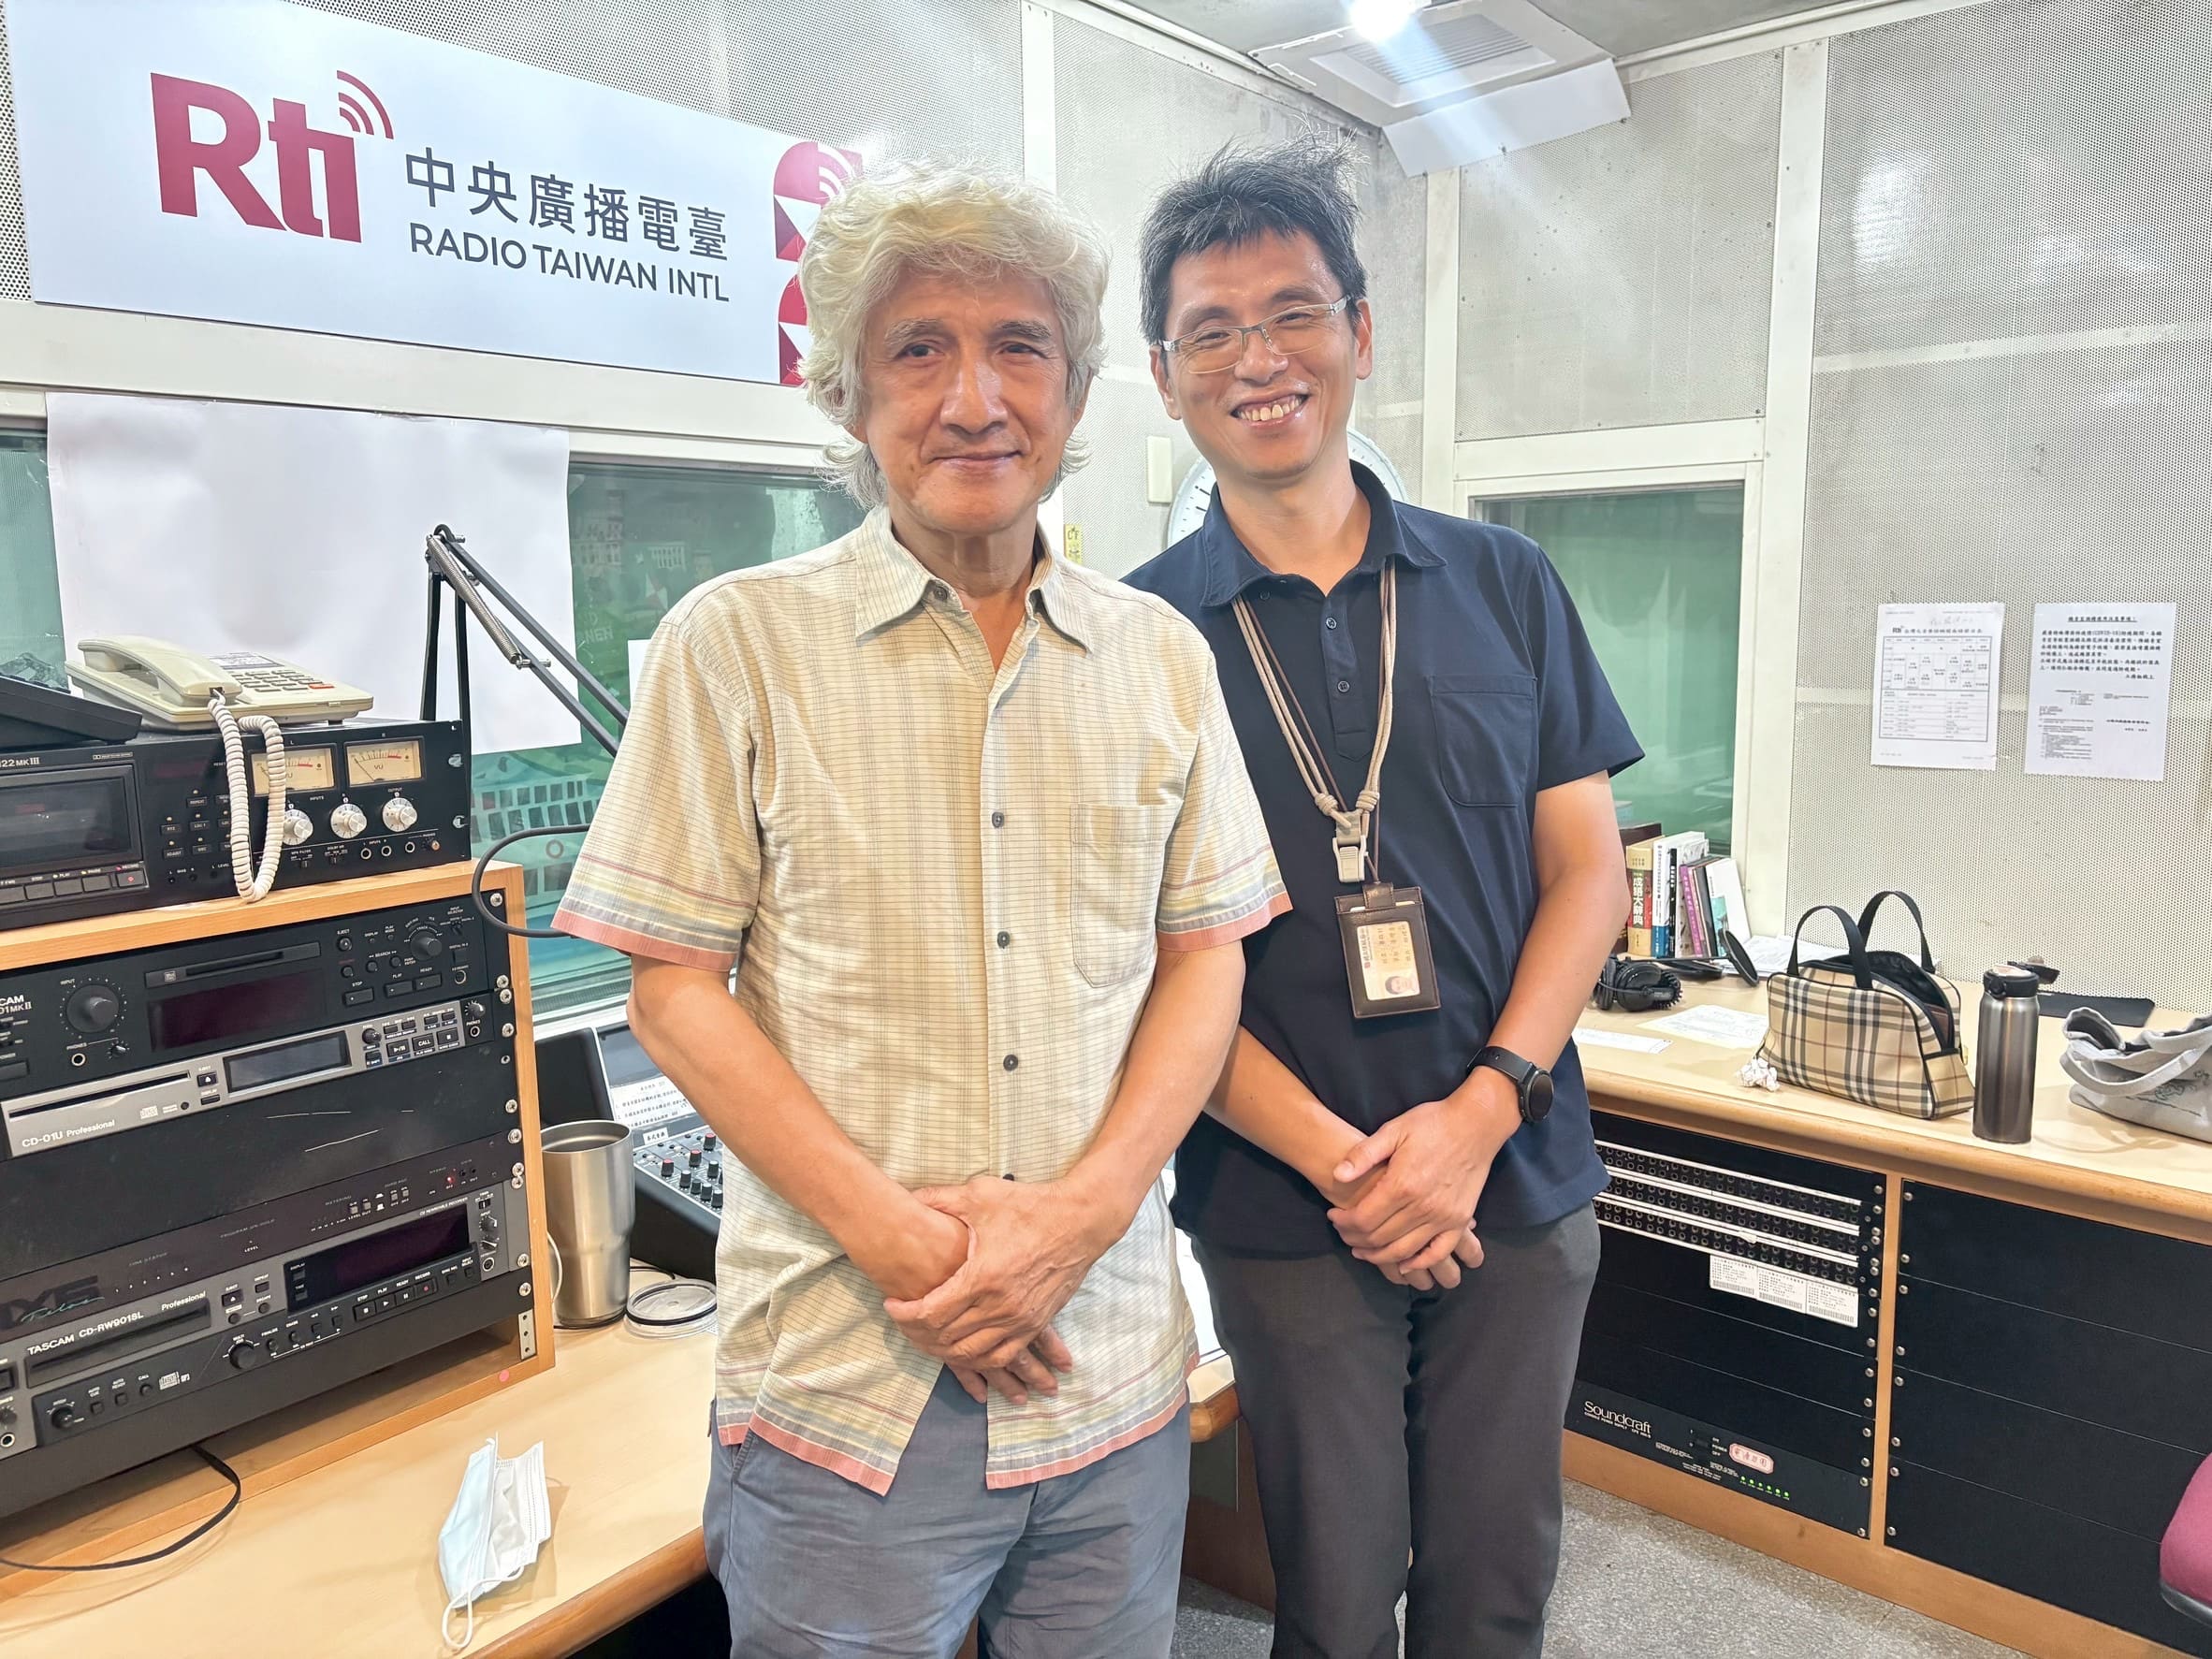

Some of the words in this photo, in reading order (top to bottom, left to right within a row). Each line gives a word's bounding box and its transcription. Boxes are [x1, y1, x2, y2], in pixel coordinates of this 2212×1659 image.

[151, 71, 363, 243] Rti
[405, 146, 729, 262] 中央廣播電臺
[411, 222, 528, 270] RADIO
[532, 243, 657, 291] TAIWAN
[667, 267, 730, 302] INTL
[66, 1119, 116, 1138] Professional
[27, 1334, 75, 1356] TASCAM
[161, 1290, 207, 1311] Professional
[1583, 1400, 1652, 1434] Soundcraft
